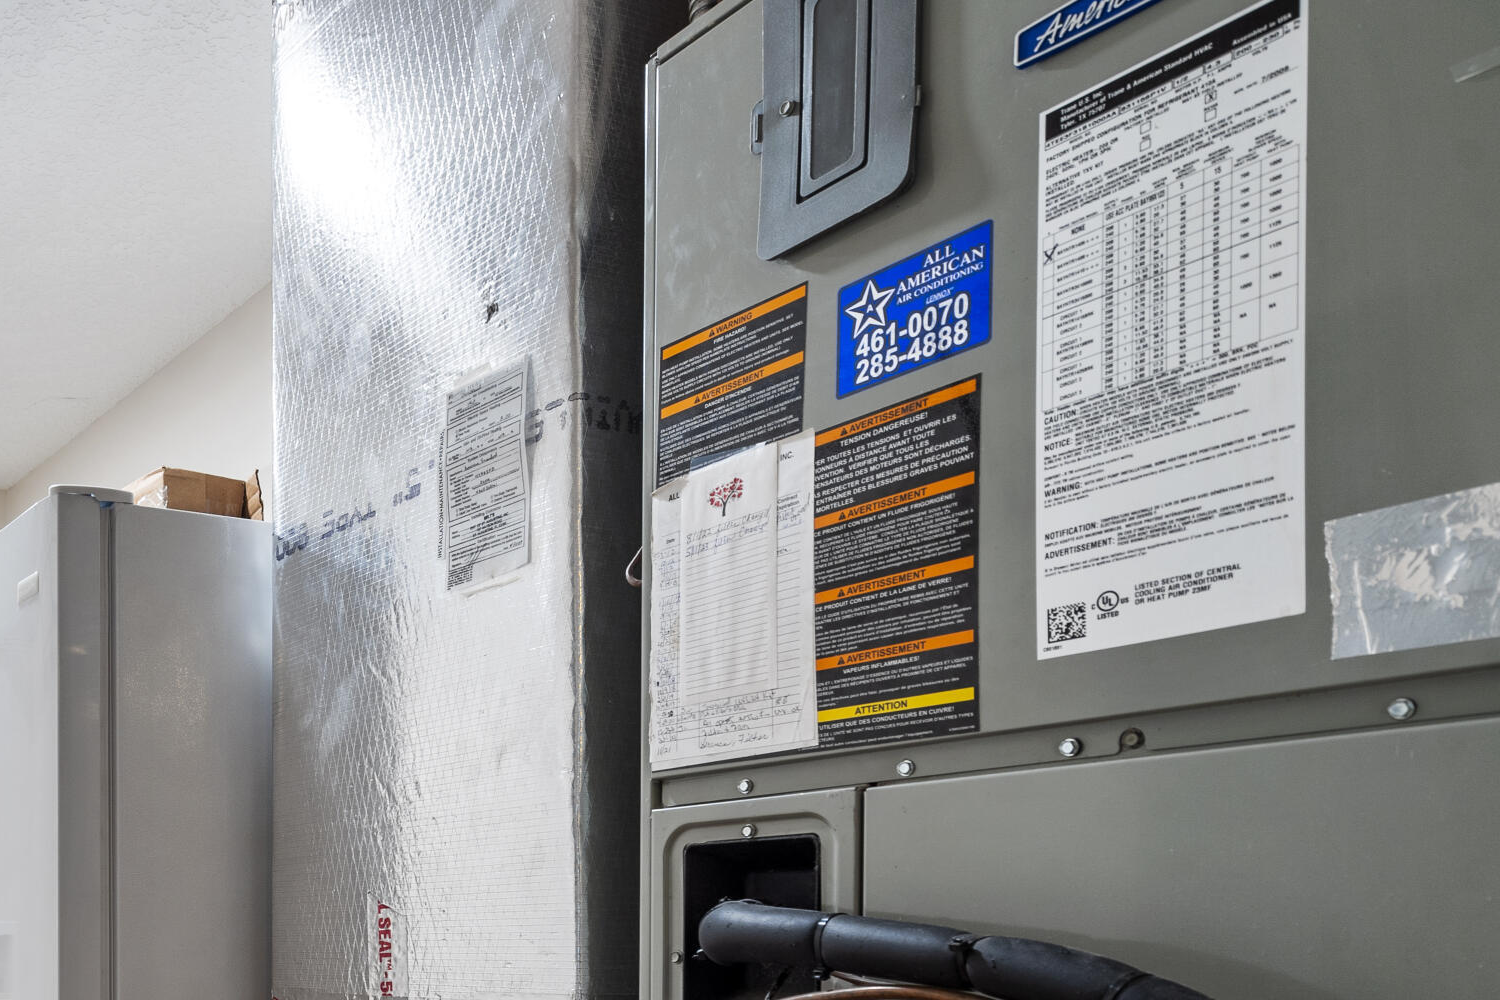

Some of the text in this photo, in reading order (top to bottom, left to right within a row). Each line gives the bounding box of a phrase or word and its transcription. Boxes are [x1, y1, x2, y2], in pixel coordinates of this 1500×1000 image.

[1232, 11, 1291, 46] Assembled in USA
[1060, 99, 1098, 123] Manufacturer
[1107, 85, 1124, 100] Trane
[1126, 82, 1131, 91] &
[1133, 67, 1162, 87] American
[1163, 52, 1192, 72] Standard
[1194, 41, 1212, 56] HVAC
[896, 245, 984, 294] AMERICAN
[924, 244, 955, 267] ALL
[896, 262, 984, 305] AIR CONDITIONING
[716, 311, 752, 334] WARNING
[855, 293, 969, 357] 461-0070
[713, 335, 723, 344] FIRE
[855, 319, 969, 384] 285-4888
[701, 368, 764, 403] AVERTISSEMENT
[840, 411, 927, 447] TENSION DANGEREUSE!
[850, 397, 928, 433] AVERTISSEMENT
[827, 413, 956, 463] TOUTES LES TENSIONS ET OUVRIR LES
[855, 445, 886, 461] DISTANCE
[888, 437, 909, 450] AVANT
[912, 428, 935, 442] TOUTE
[880, 450, 893, 461] QUE
[896, 444, 913, 456] TOUS
[915, 438, 929, 449] LES
[668, 451, 794, 502] ALL INC.
[822, 479, 859, 496] RESPECTER
[861, 474, 874, 484] CES
[875, 464, 908, 479] MESURES
[910, 460, 919, 468] DE
[853, 485, 865, 494] DES
[867, 472, 907, 490] BLESSURES
[909, 462, 938, 477] GRAVES
[940, 451, 974, 468] POUVANT
[855, 466, 868, 476] DES
[870, 456, 901, 472] MOTEURS
[904, 449, 922, 461] SONT
[847, 486, 927, 518] AVERTISSEMENT
[1044, 481, 1083, 498] WARNING:
[822, 523, 846, 536] PRODUIT
[847, 514, 876, 529] CONTIENT
[878, 512, 885, 520] UN
[887, 505, 908, 517] FLUIDE
[1044, 521, 1098, 540] NOTIFICATION:
[1044, 537, 1116, 560] ADVERTISSEMENT:
[823, 600, 848, 610] PRODUIT
[849, 593, 878, 605] CONTIENT
[898, 584, 916, 594] LAINE
[927, 575, 951, 587] VERRE!
[846, 568, 925, 595] AVERTISSEMENT
[1134, 580, 1159, 591] LISTED
[1161, 573, 1192, 585] SECTION
[1206, 563, 1242, 576] CENTRAL
[1134, 572, 1234, 598] COOLING AIR CONDITIONER
[1134, 597, 1145, 605] OR
[1147, 593, 1166, 603] HEAT
[1168, 588, 1190, 599] PUMP
[1097, 610, 1119, 620] LISTED
[843, 654, 919, 674] VAPEURS INFLAMMABLES!
[846, 640, 925, 663] AVERTISSEMENT
[854, 699, 908, 715] ATTENTION
